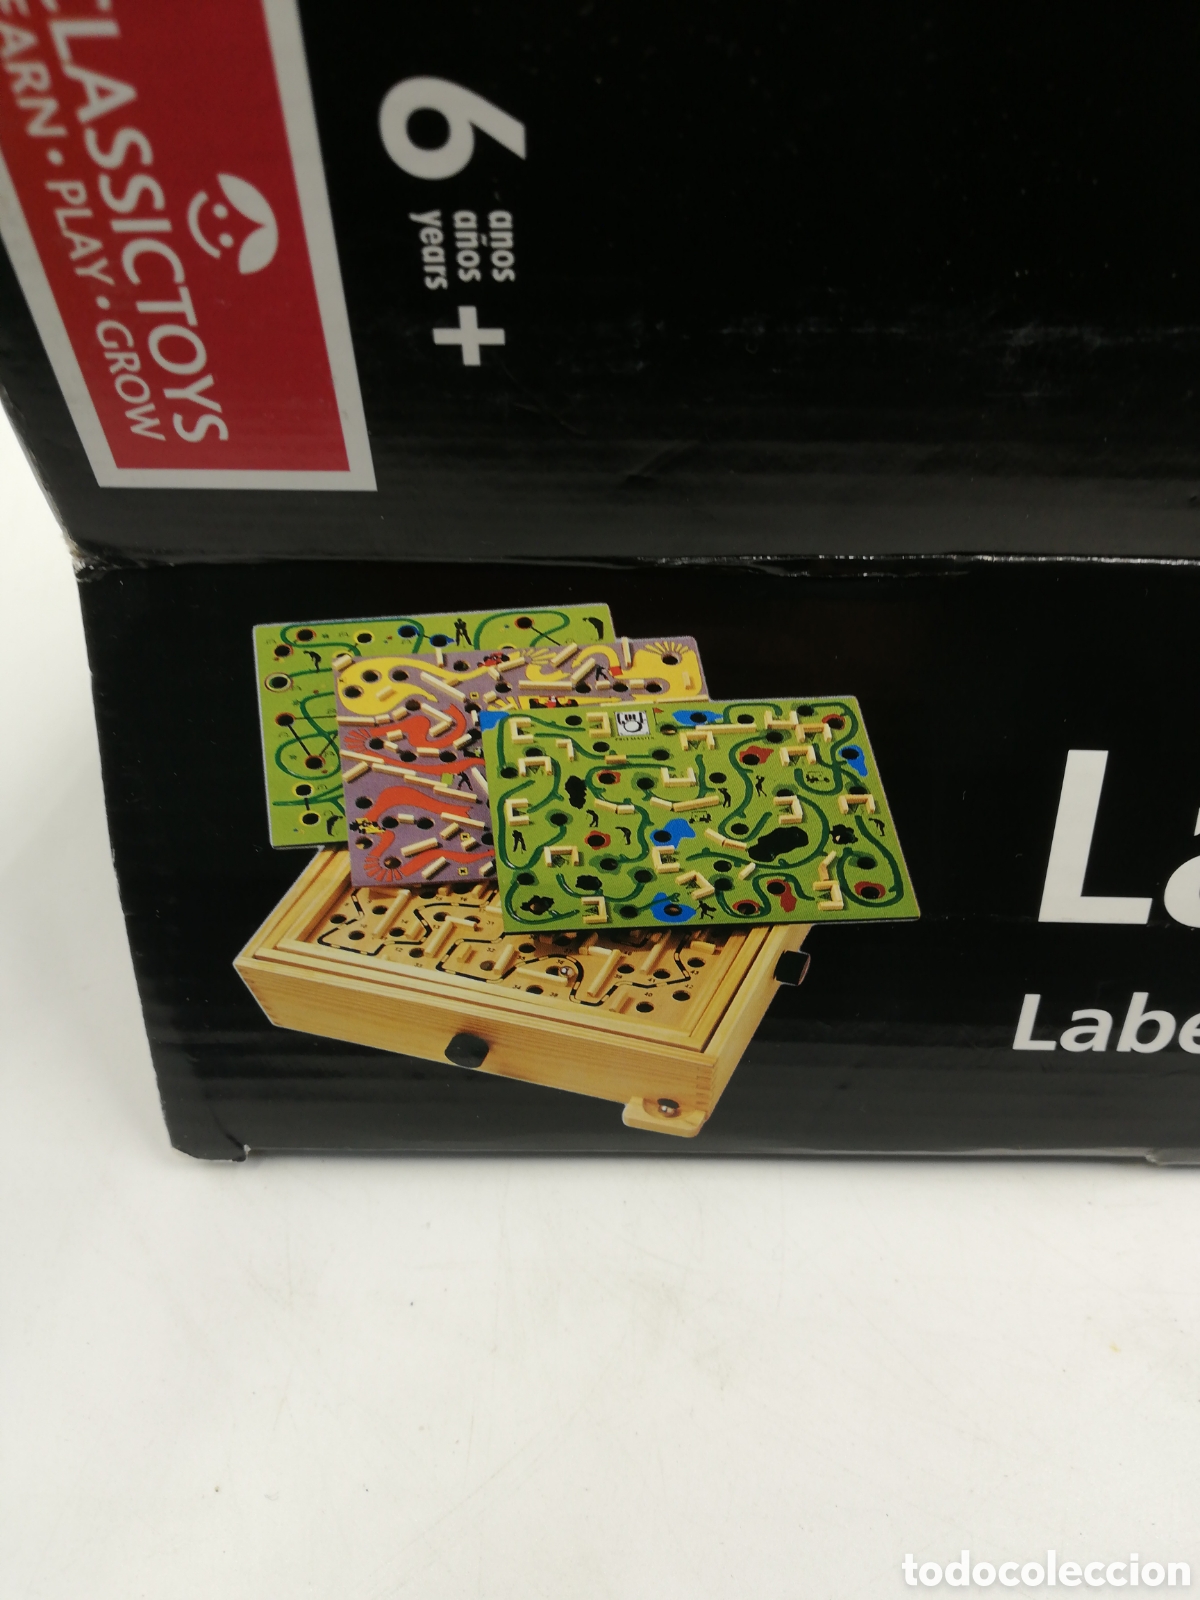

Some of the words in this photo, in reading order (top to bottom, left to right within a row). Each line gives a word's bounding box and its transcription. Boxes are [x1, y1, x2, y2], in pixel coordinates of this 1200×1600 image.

[378, 75, 527, 180] 6
[42, 0, 229, 443] LASSICTOYS
[408, 209, 448, 290] years
[453, 210, 488, 282] años
[487, 210, 516, 282] anos
[45, 180, 115, 287] PLAY
[96, 319, 168, 442] GROW
[432, 305, 506, 366] +
